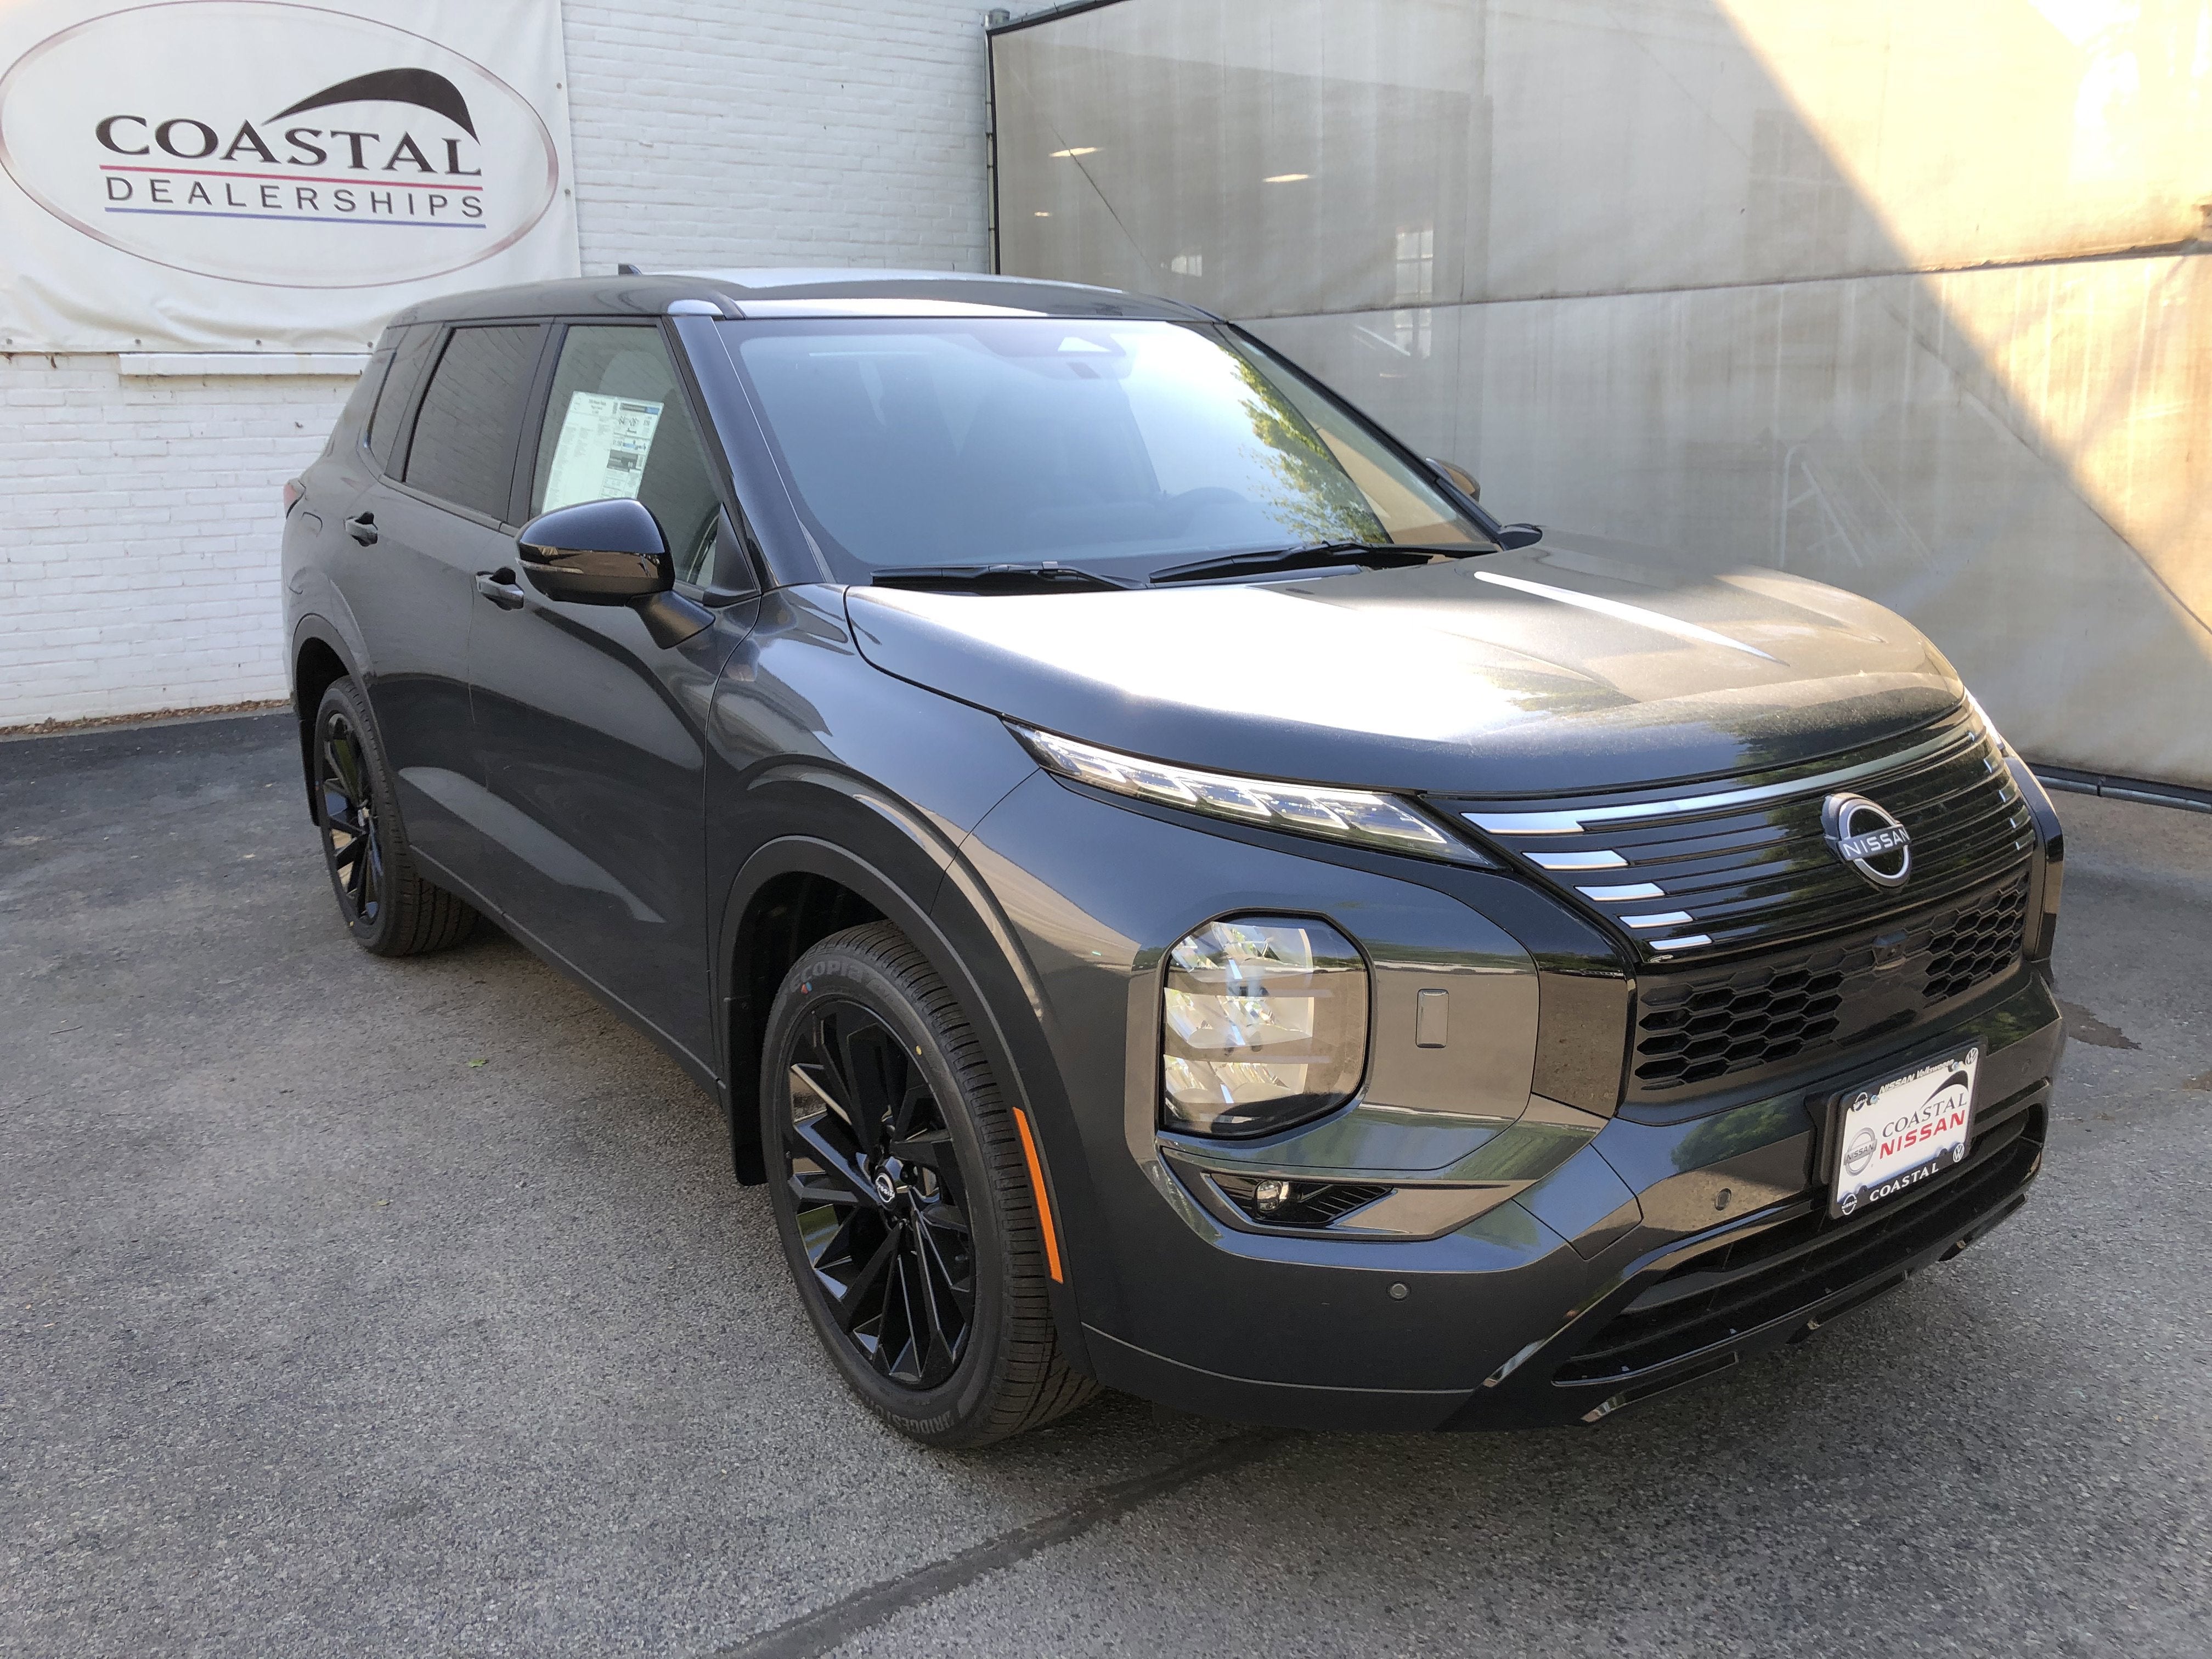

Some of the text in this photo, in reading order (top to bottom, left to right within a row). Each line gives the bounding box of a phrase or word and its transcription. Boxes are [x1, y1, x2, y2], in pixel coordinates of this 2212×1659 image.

[95, 114, 482, 177] COASTAL
[105, 176, 483, 218] DEALERSHIPS
[1842, 828, 1910, 857] NISSAN
[1879, 1073, 1915, 1094] NISSAN
[1880, 1110, 1965, 1159] NISSAN
[1882, 1092, 1967, 1138] COASTAL
[1846, 1143, 1874, 1161] NISSAN
[1870, 1163, 1939, 1201] COASTAL
